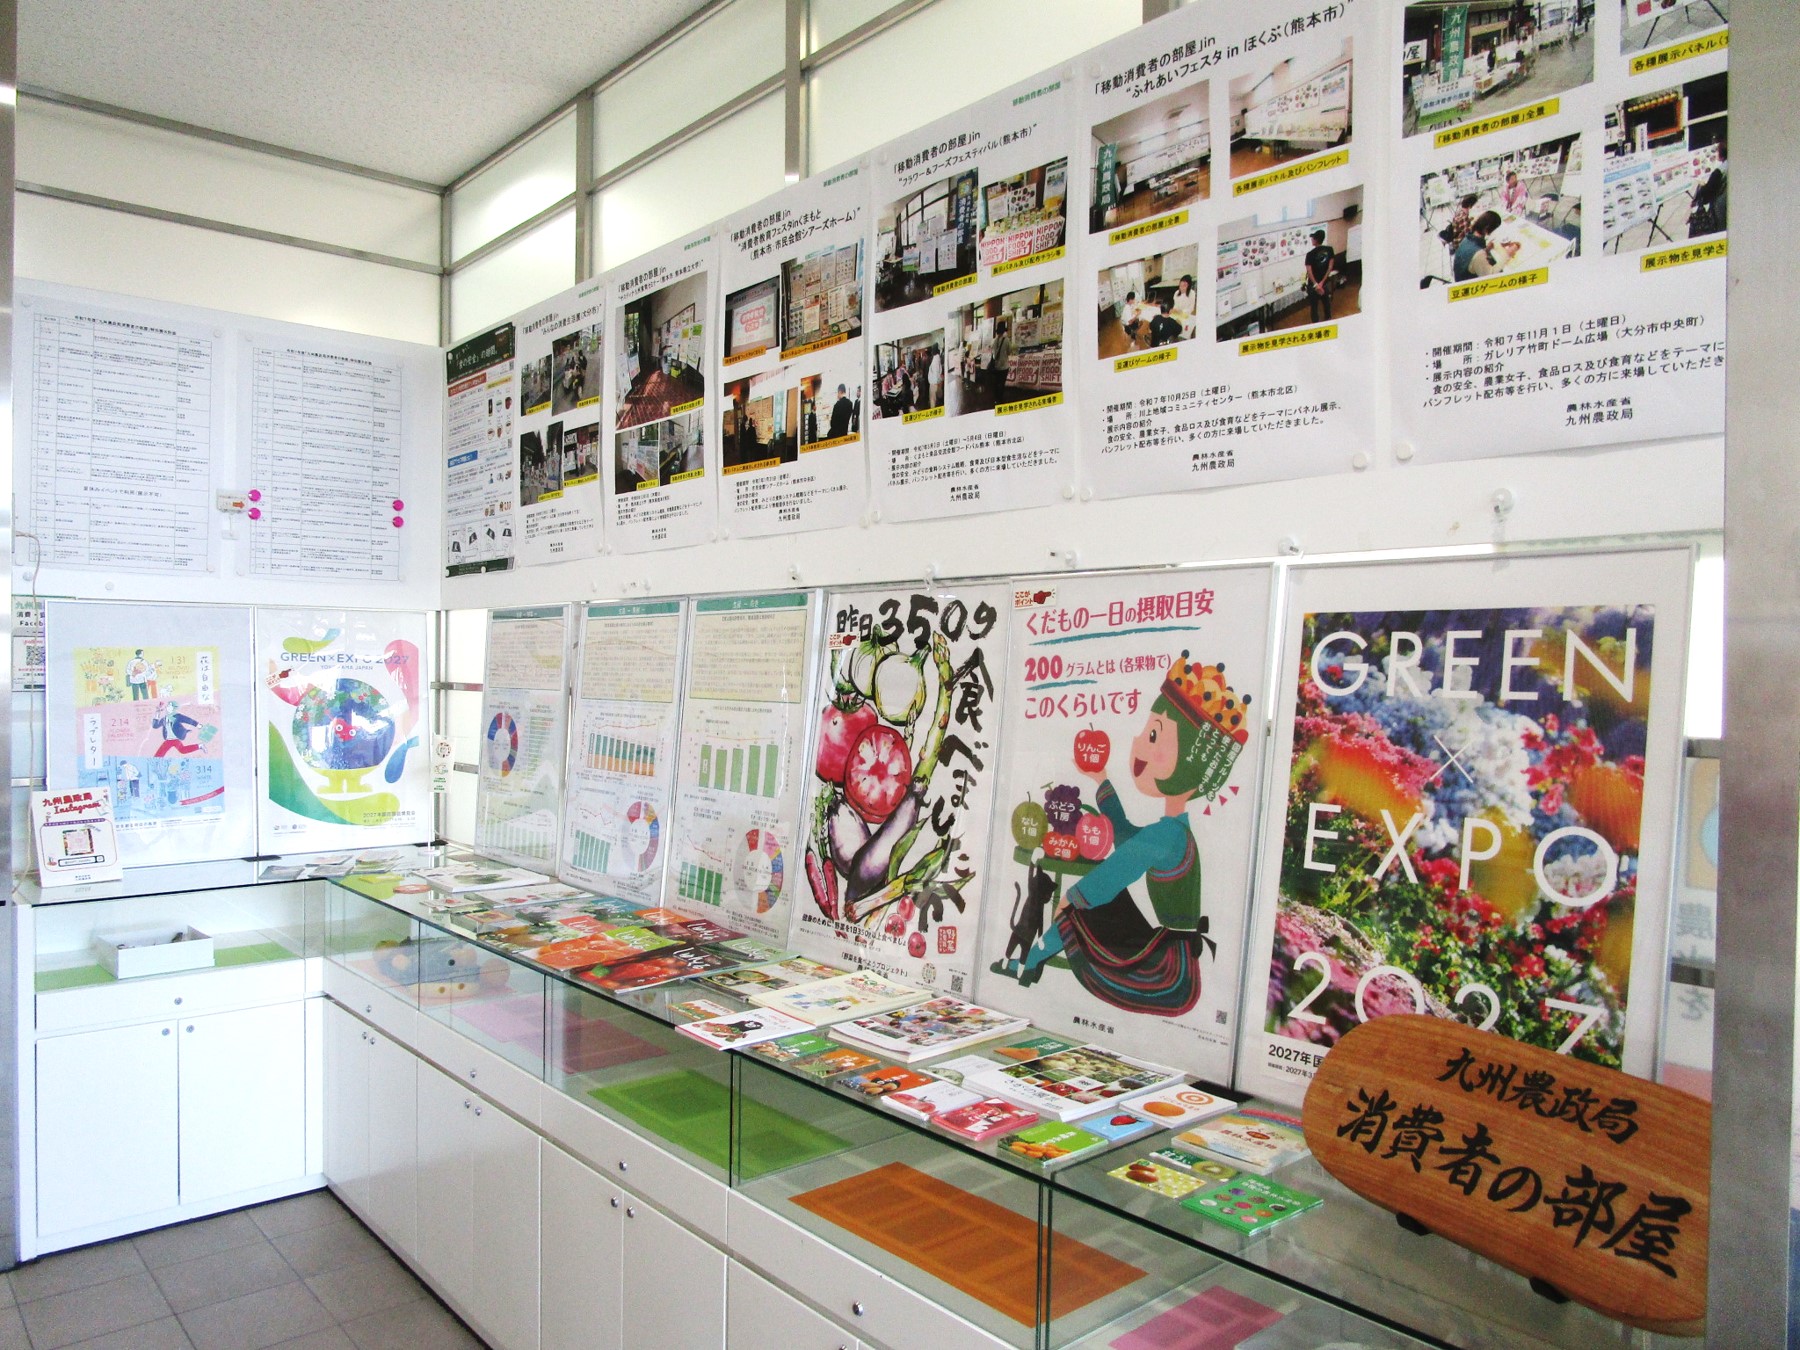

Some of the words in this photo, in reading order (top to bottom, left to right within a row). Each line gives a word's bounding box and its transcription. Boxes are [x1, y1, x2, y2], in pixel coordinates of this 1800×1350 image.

[1226, 45, 1239, 59] in
[1235, 155, 1342, 194] 各種展示パネル及びパンフレット
[1451, 273, 1538, 299] 豆運びゲームの様子
[1241, 329, 1332, 353] 展示物を見学される来場者
[1117, 351, 1172, 370] 豆運びゲームの様子
[1566, 397, 1631, 413] 農林水産省
[1565, 409, 1633, 426] 九州農政局
[1192, 450, 1234, 461] 農林水産省
[1191, 459, 1235, 472] 九州農政局
[1014, 591, 1031, 599] ここが
[1014, 598, 1033, 606] ポイント
[1026, 588, 1215, 636] くだもの一日の摂取目安
[1311, 627, 1637, 703] GREEN
[1025, 689, 1142, 719] このくらいです
[1077, 742, 1105, 754] りんご
[54, 801, 101, 815] Instagram
[1049, 802, 1076, 813] ぶどう
[1021, 816, 1038, 827] なし
[1082, 824, 1101, 835] もも
[1048, 836, 1078, 849] みかん
[1303, 802, 1619, 906] EXPO
[1073, 1015, 1115, 1034] 農林水産省
[1436, 1047, 1639, 1145] 九州農政局
[1336, 1087, 1692, 1279] 消費者の部屋
